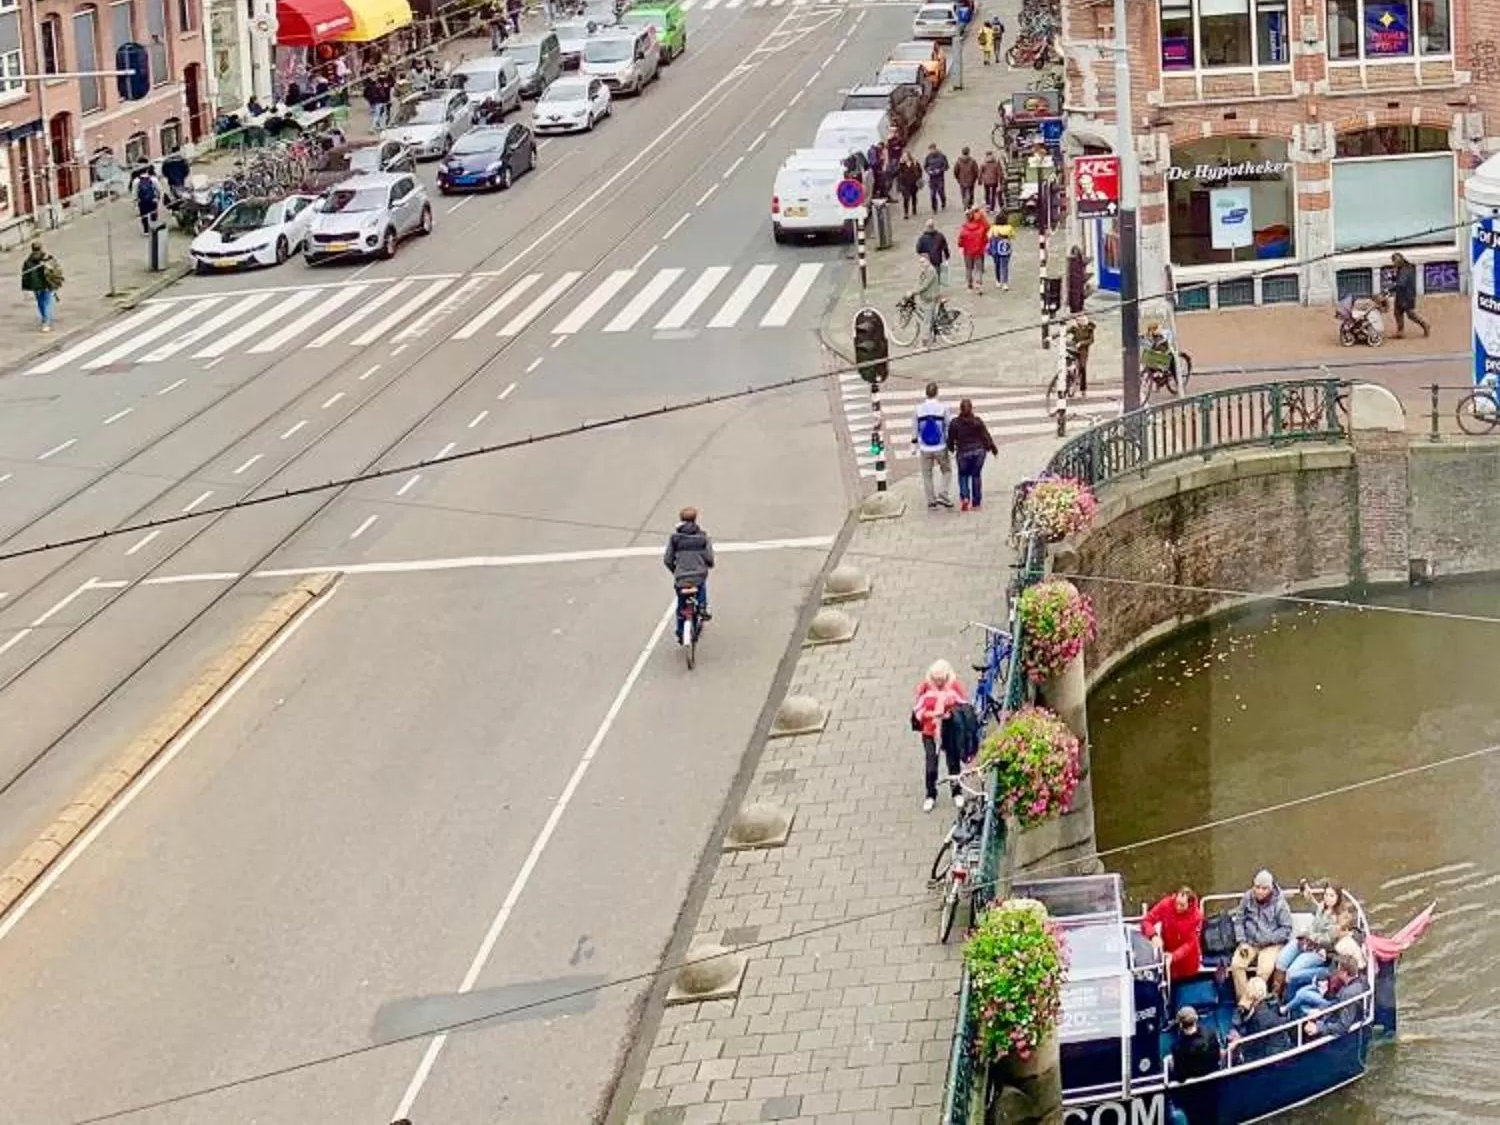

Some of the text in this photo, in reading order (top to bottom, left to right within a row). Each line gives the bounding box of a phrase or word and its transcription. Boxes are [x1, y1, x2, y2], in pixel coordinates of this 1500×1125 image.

[1079, 160, 1114, 174] KFC
[1168, 160, 1289, 180] De Hypotheker
